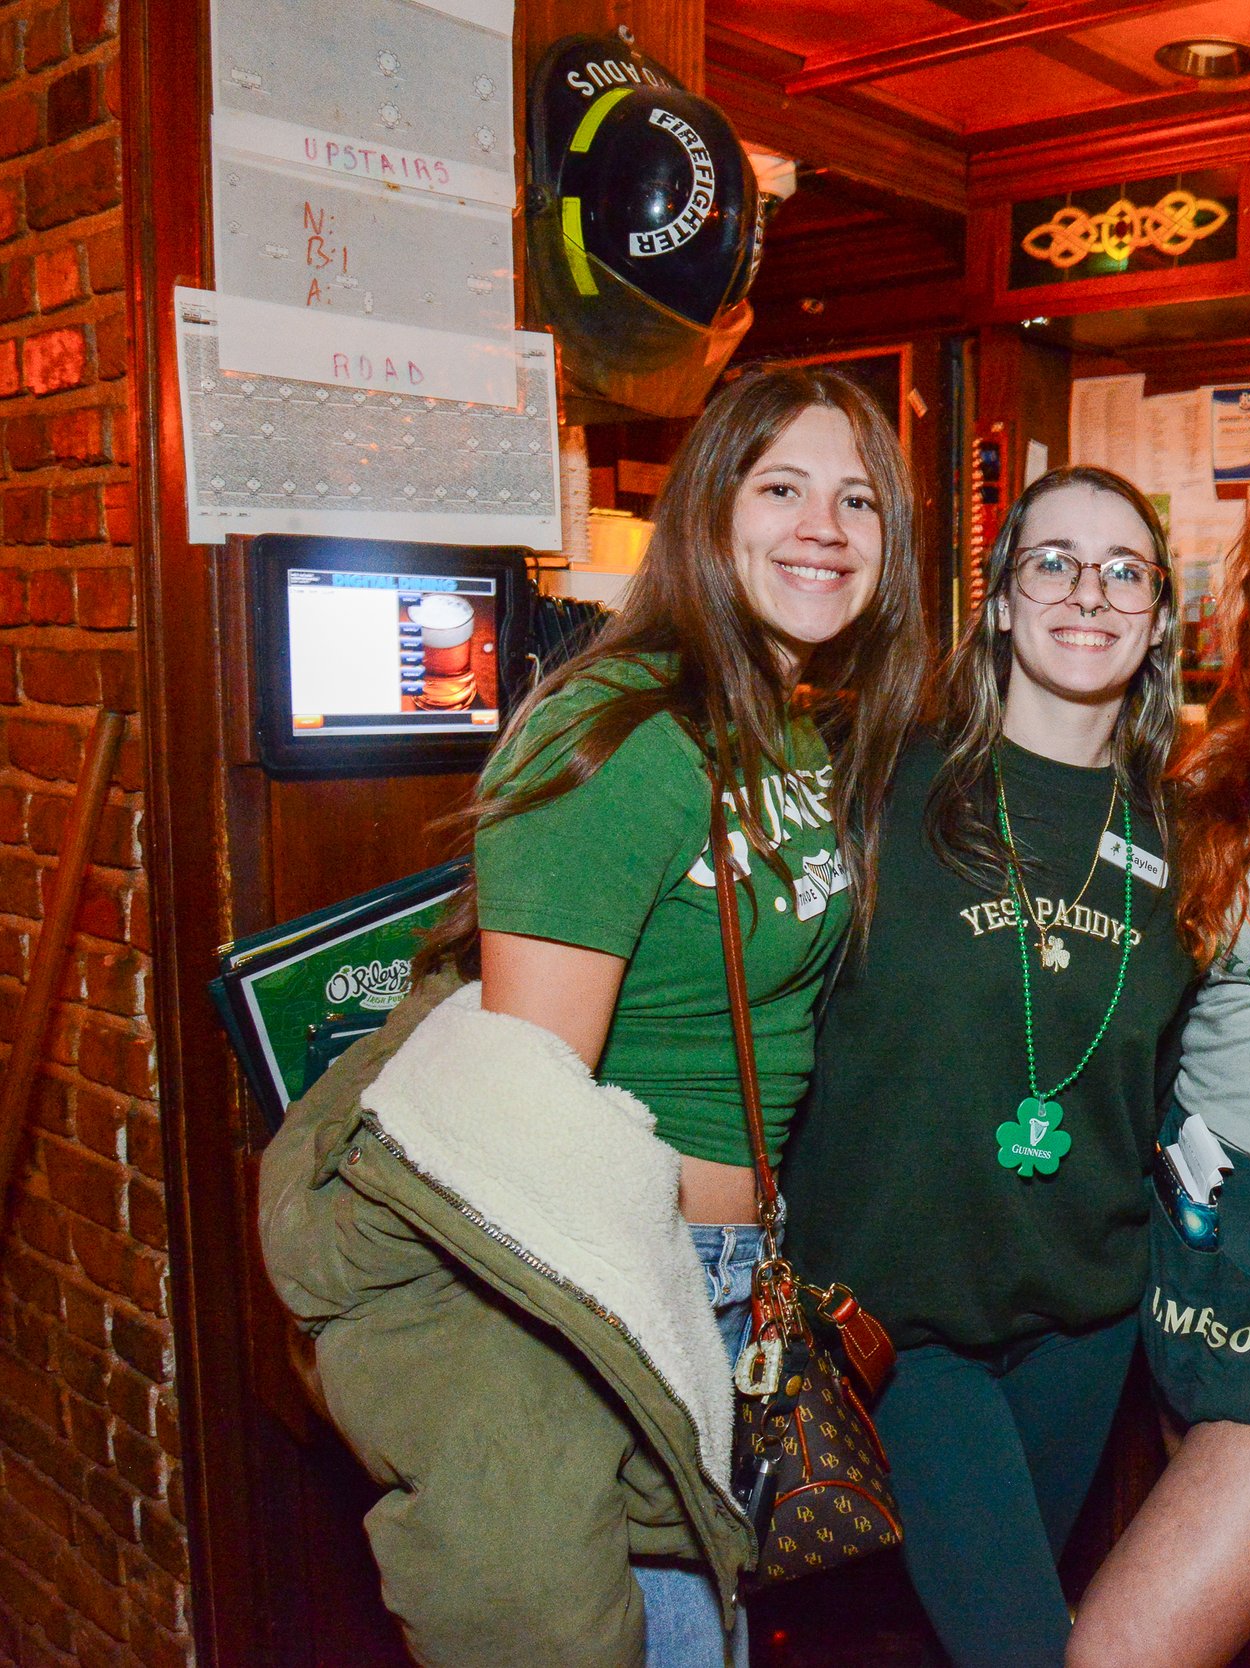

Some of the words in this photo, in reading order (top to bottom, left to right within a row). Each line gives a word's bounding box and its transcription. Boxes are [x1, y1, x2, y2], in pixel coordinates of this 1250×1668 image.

[304, 137, 450, 185] UPSTAIRS
[635, 111, 714, 257] FIREFIGHTER
[333, 352, 425, 386] ROAD
[332, 574, 398, 589] DIGITAL
[399, 576, 458, 592] DINING
[1011, 1143, 1052, 1160] GUINNESS
